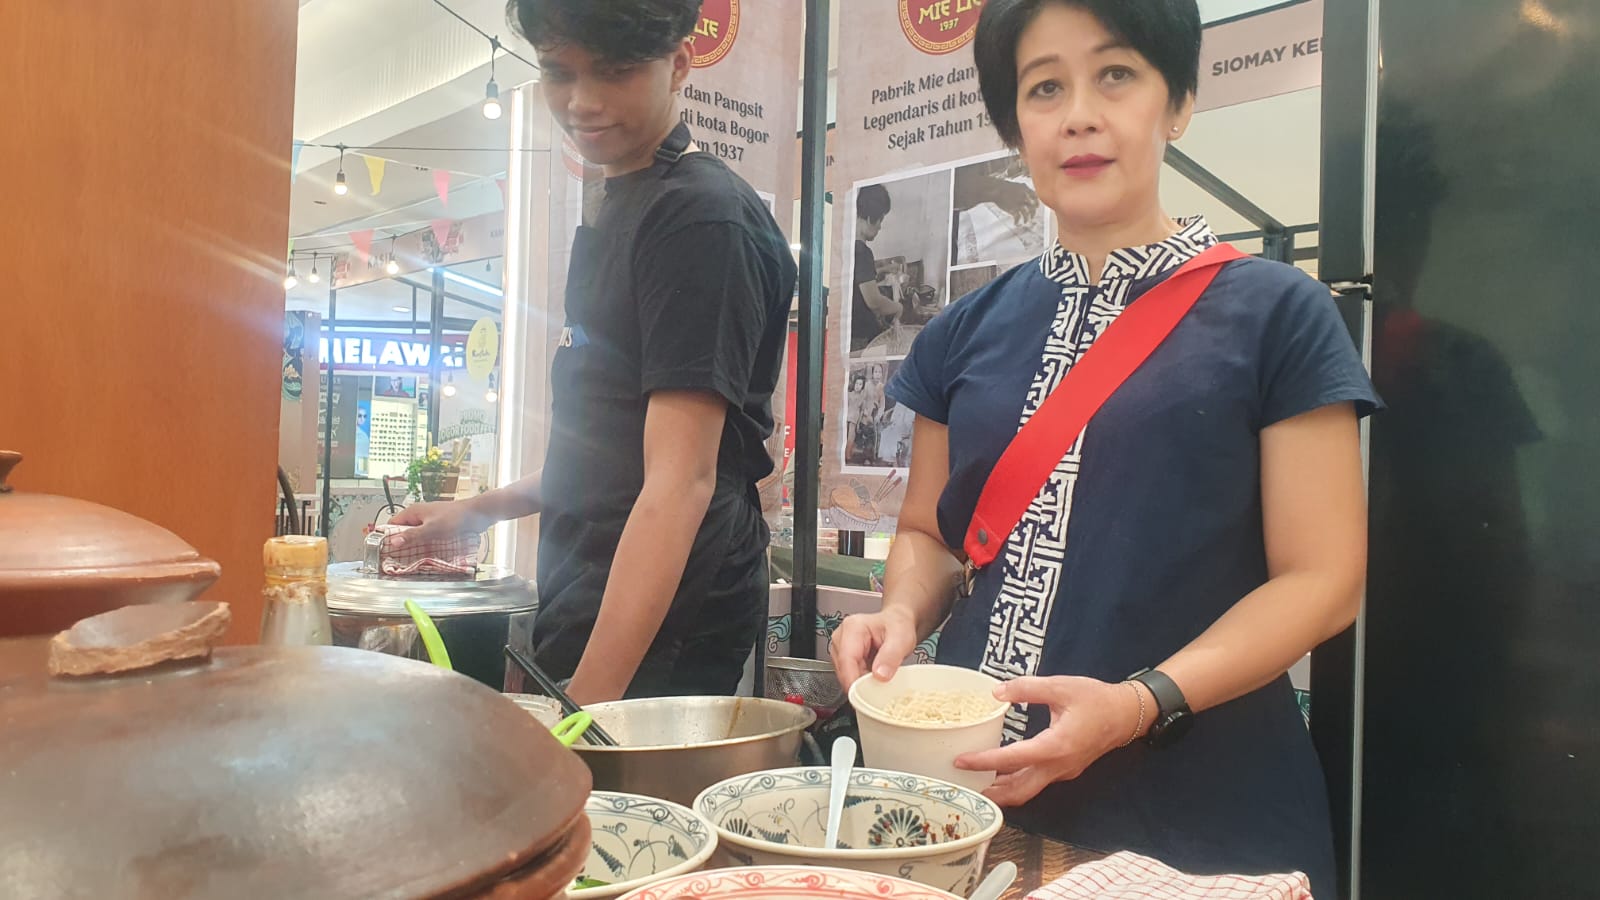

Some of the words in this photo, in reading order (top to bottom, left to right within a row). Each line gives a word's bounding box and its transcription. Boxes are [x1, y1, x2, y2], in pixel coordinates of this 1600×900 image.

[918, 0, 950, 24] MIE
[940, 17, 959, 32] 1937
[1212, 46, 1287, 76] SIOMAY
[1292, 37, 1323, 58] KE
[684, 83, 711, 105] dan
[714, 91, 764, 119] Pangsit
[872, 80, 916, 105] Pabrik
[918, 73, 944, 92] Mie
[947, 67, 975, 85] dan
[680, 108, 693, 126] di
[697, 111, 727, 134] kota
[730, 120, 770, 144] Bogor
[863, 100, 940, 131] Legendaris
[942, 93, 955, 111] di
[959, 90, 983, 107] kot
[887, 127, 925, 151] Sejak
[927, 118, 973, 140] Tahun
[976, 109, 991, 128] 19
[713, 141, 744, 161] 1937
